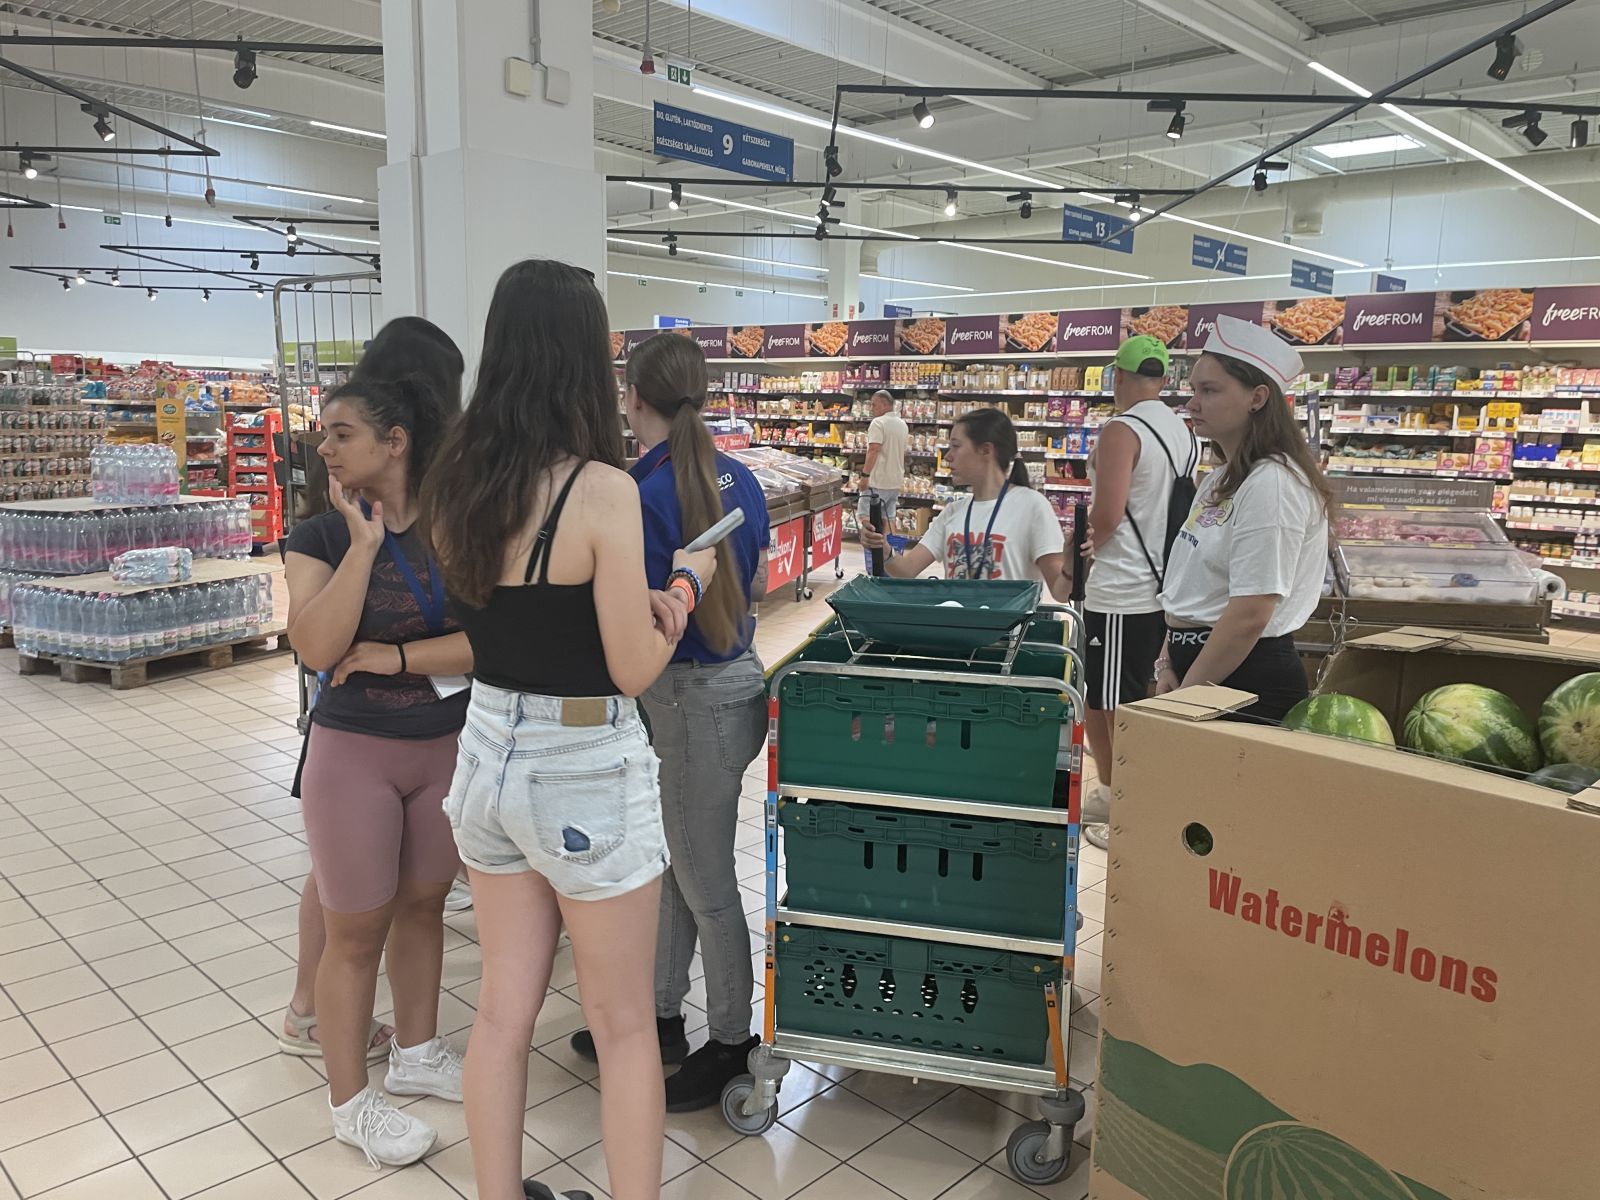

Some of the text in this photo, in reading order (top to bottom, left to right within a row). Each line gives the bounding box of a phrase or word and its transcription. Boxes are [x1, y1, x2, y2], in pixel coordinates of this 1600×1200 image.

[656, 110, 665, 121] BIO,
[722, 134, 734, 156] 9
[1095, 221, 1106, 238] 13
[1310, 271, 1317, 283] 15
[1352, 308, 1423, 332] freeFROM
[1542, 302, 1600, 327] freeFR
[852, 330, 889, 348] freeFROM
[950, 327, 993, 344] freeFROM
[1064, 322, 1113, 340] freeFROM
[767, 335, 800, 350] freeFROM
[717, 473, 732, 487] SCO
[1359, 486, 1397, 494] valamivel
[1397, 487, 1416, 495] nem
[1379, 496, 1424, 505] visszaadjuk
[1208, 867, 1498, 1004] Watermelons
